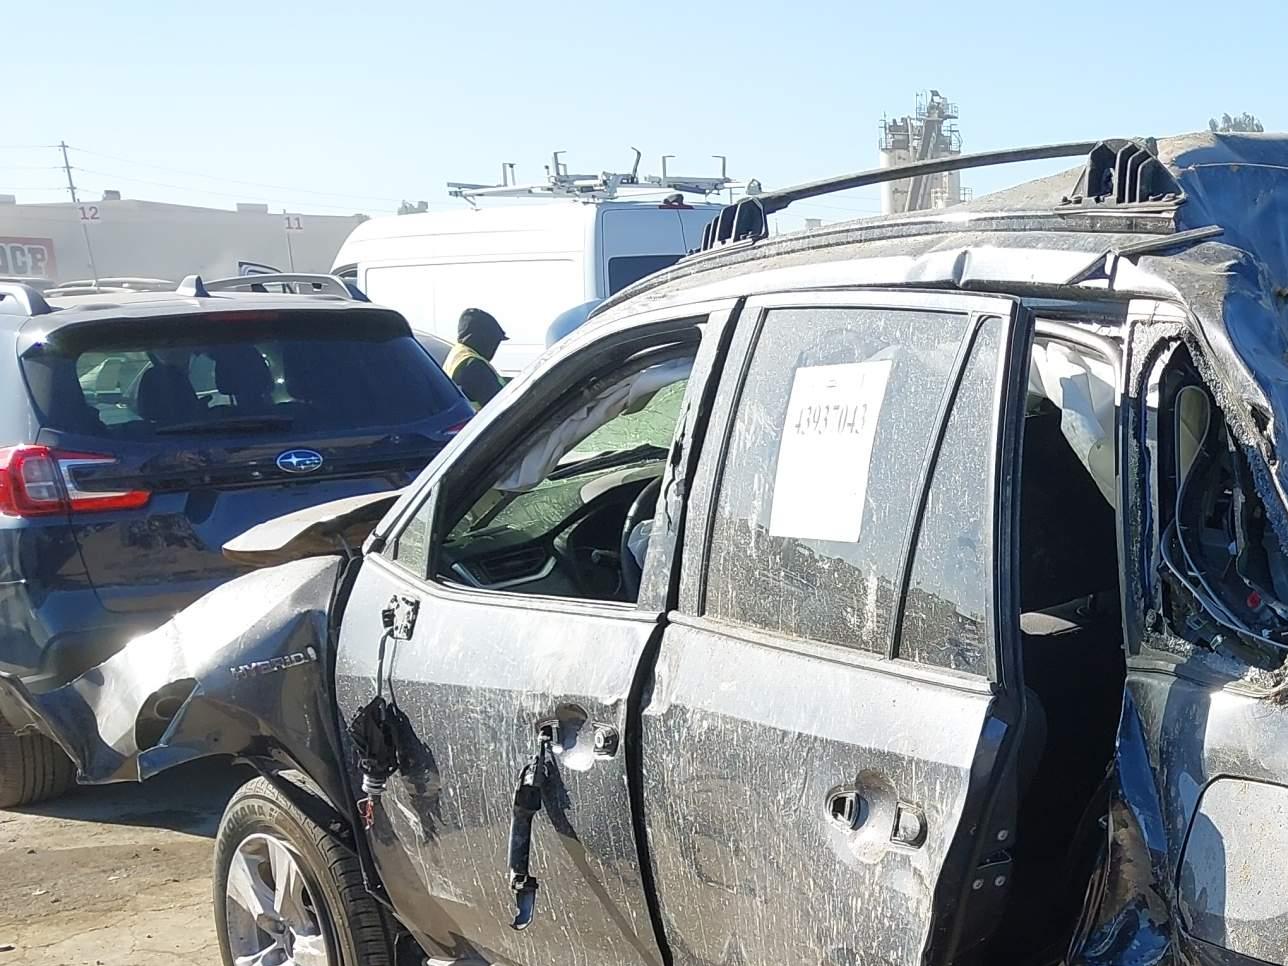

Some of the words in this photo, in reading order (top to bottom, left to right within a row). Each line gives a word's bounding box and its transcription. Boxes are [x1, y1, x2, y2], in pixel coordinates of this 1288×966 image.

[79, 206, 100, 220] 12
[285, 216, 304, 230] 11
[218, 804, 266, 860] OKOHAMA
